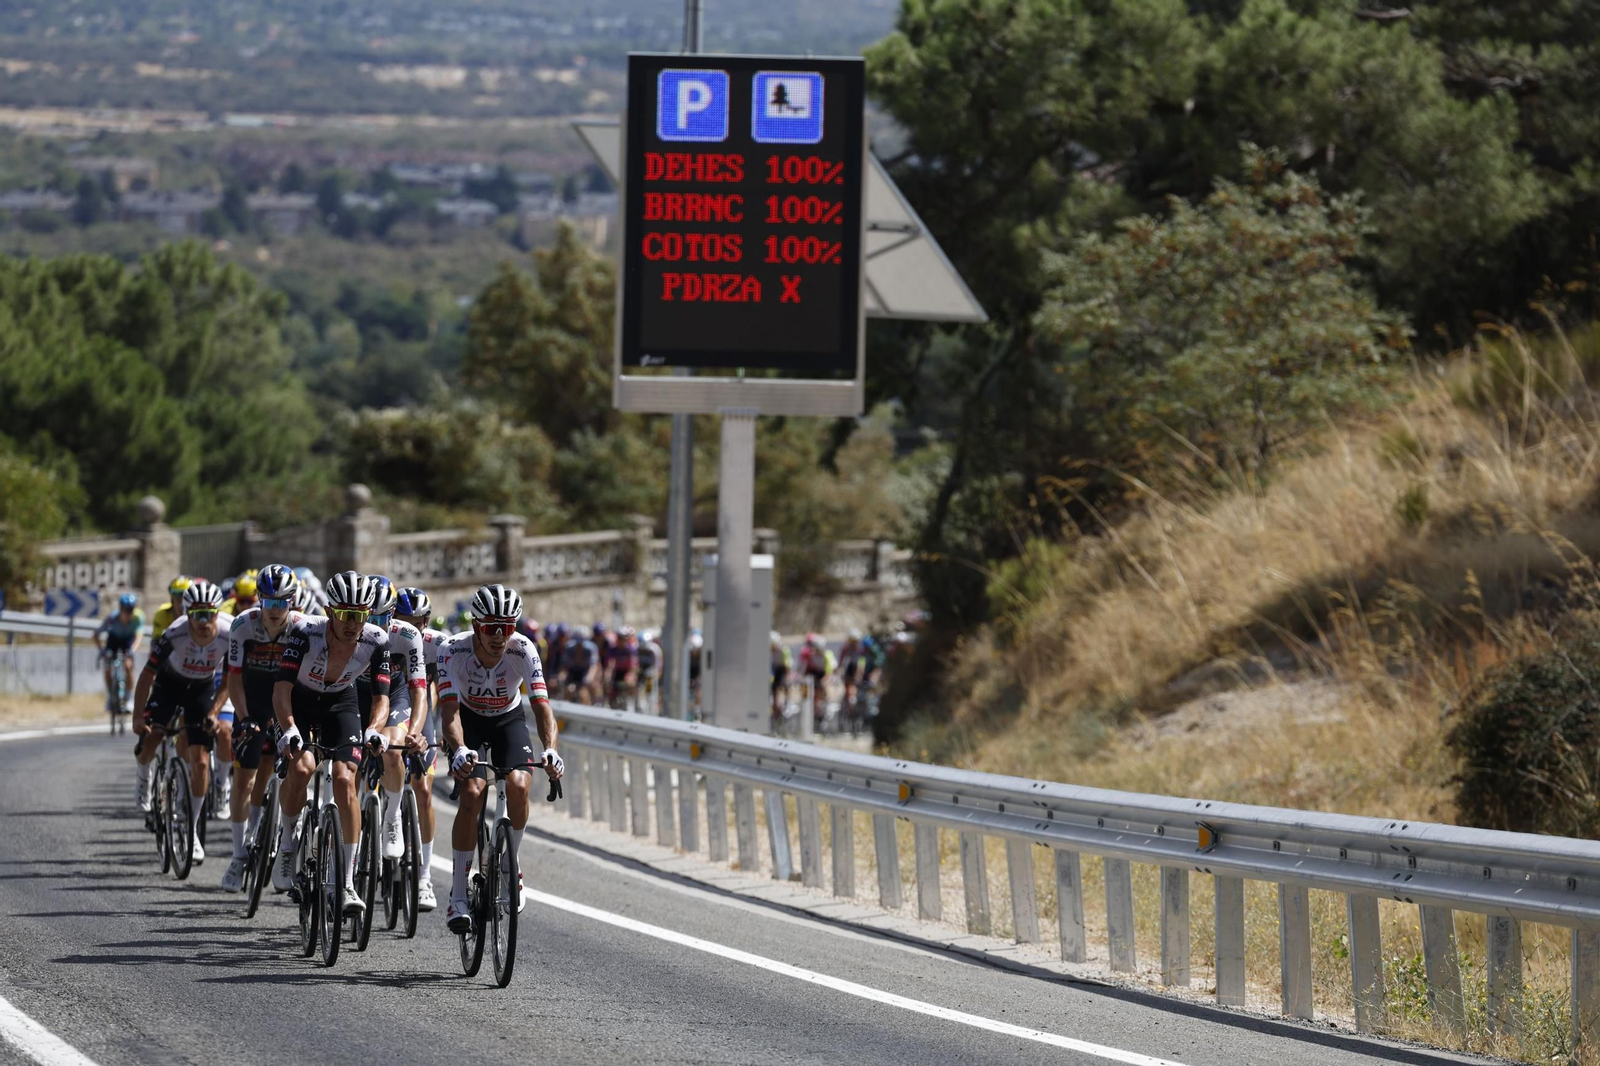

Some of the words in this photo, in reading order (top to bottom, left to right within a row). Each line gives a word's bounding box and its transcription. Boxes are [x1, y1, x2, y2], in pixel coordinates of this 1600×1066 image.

[677, 80, 712, 130] P
[644, 152, 745, 182] DEHES
[765, 155, 844, 185] 100%
[643, 192, 743, 223] BRRNC
[764, 195, 843, 225] 100%
[642, 232, 743, 262] COTOS
[763, 235, 842, 265] 100%
[660, 272, 762, 302] PDRZA
[780, 275, 802, 303] X
[229, 639, 239, 662] BOSS
[468, 686, 509, 697] UAE
